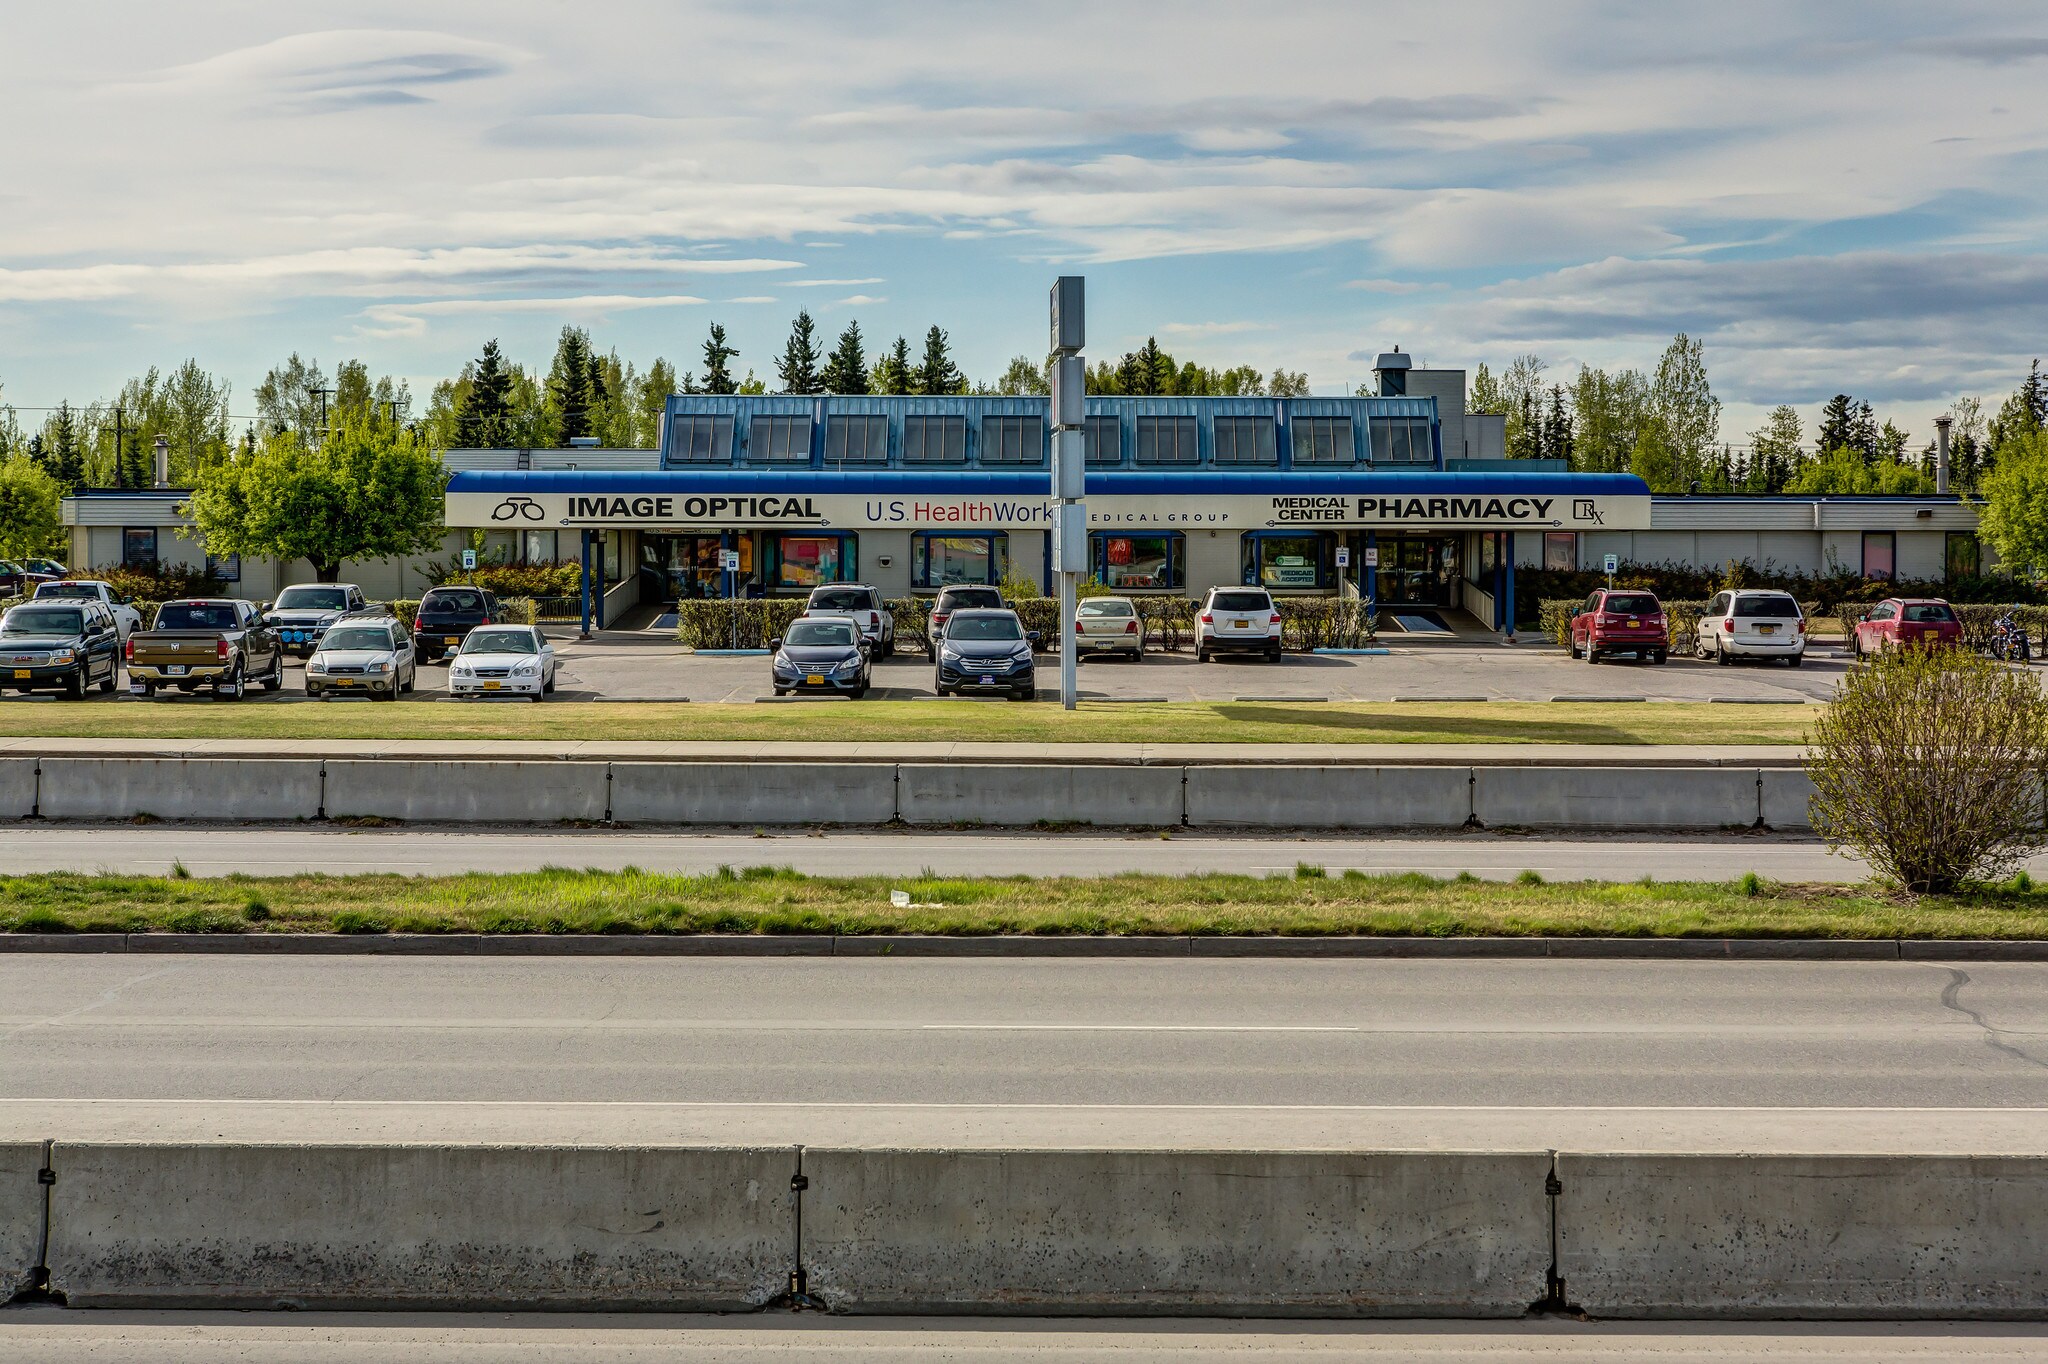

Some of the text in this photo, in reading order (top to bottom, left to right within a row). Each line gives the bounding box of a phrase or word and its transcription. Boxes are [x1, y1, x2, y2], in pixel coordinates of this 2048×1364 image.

[569, 497, 821, 518] IMAGE OPTICAL
[1272, 497, 1349, 508] MEDICAL
[1357, 498, 1554, 518] PHARMACY
[866, 501, 1054, 522] U.S. HealthWork
[1278, 509, 1345, 521] CENTER
[1092, 513, 1229, 523] EDICAL GROUP
[1123, 575, 1152, 586] OPEN
